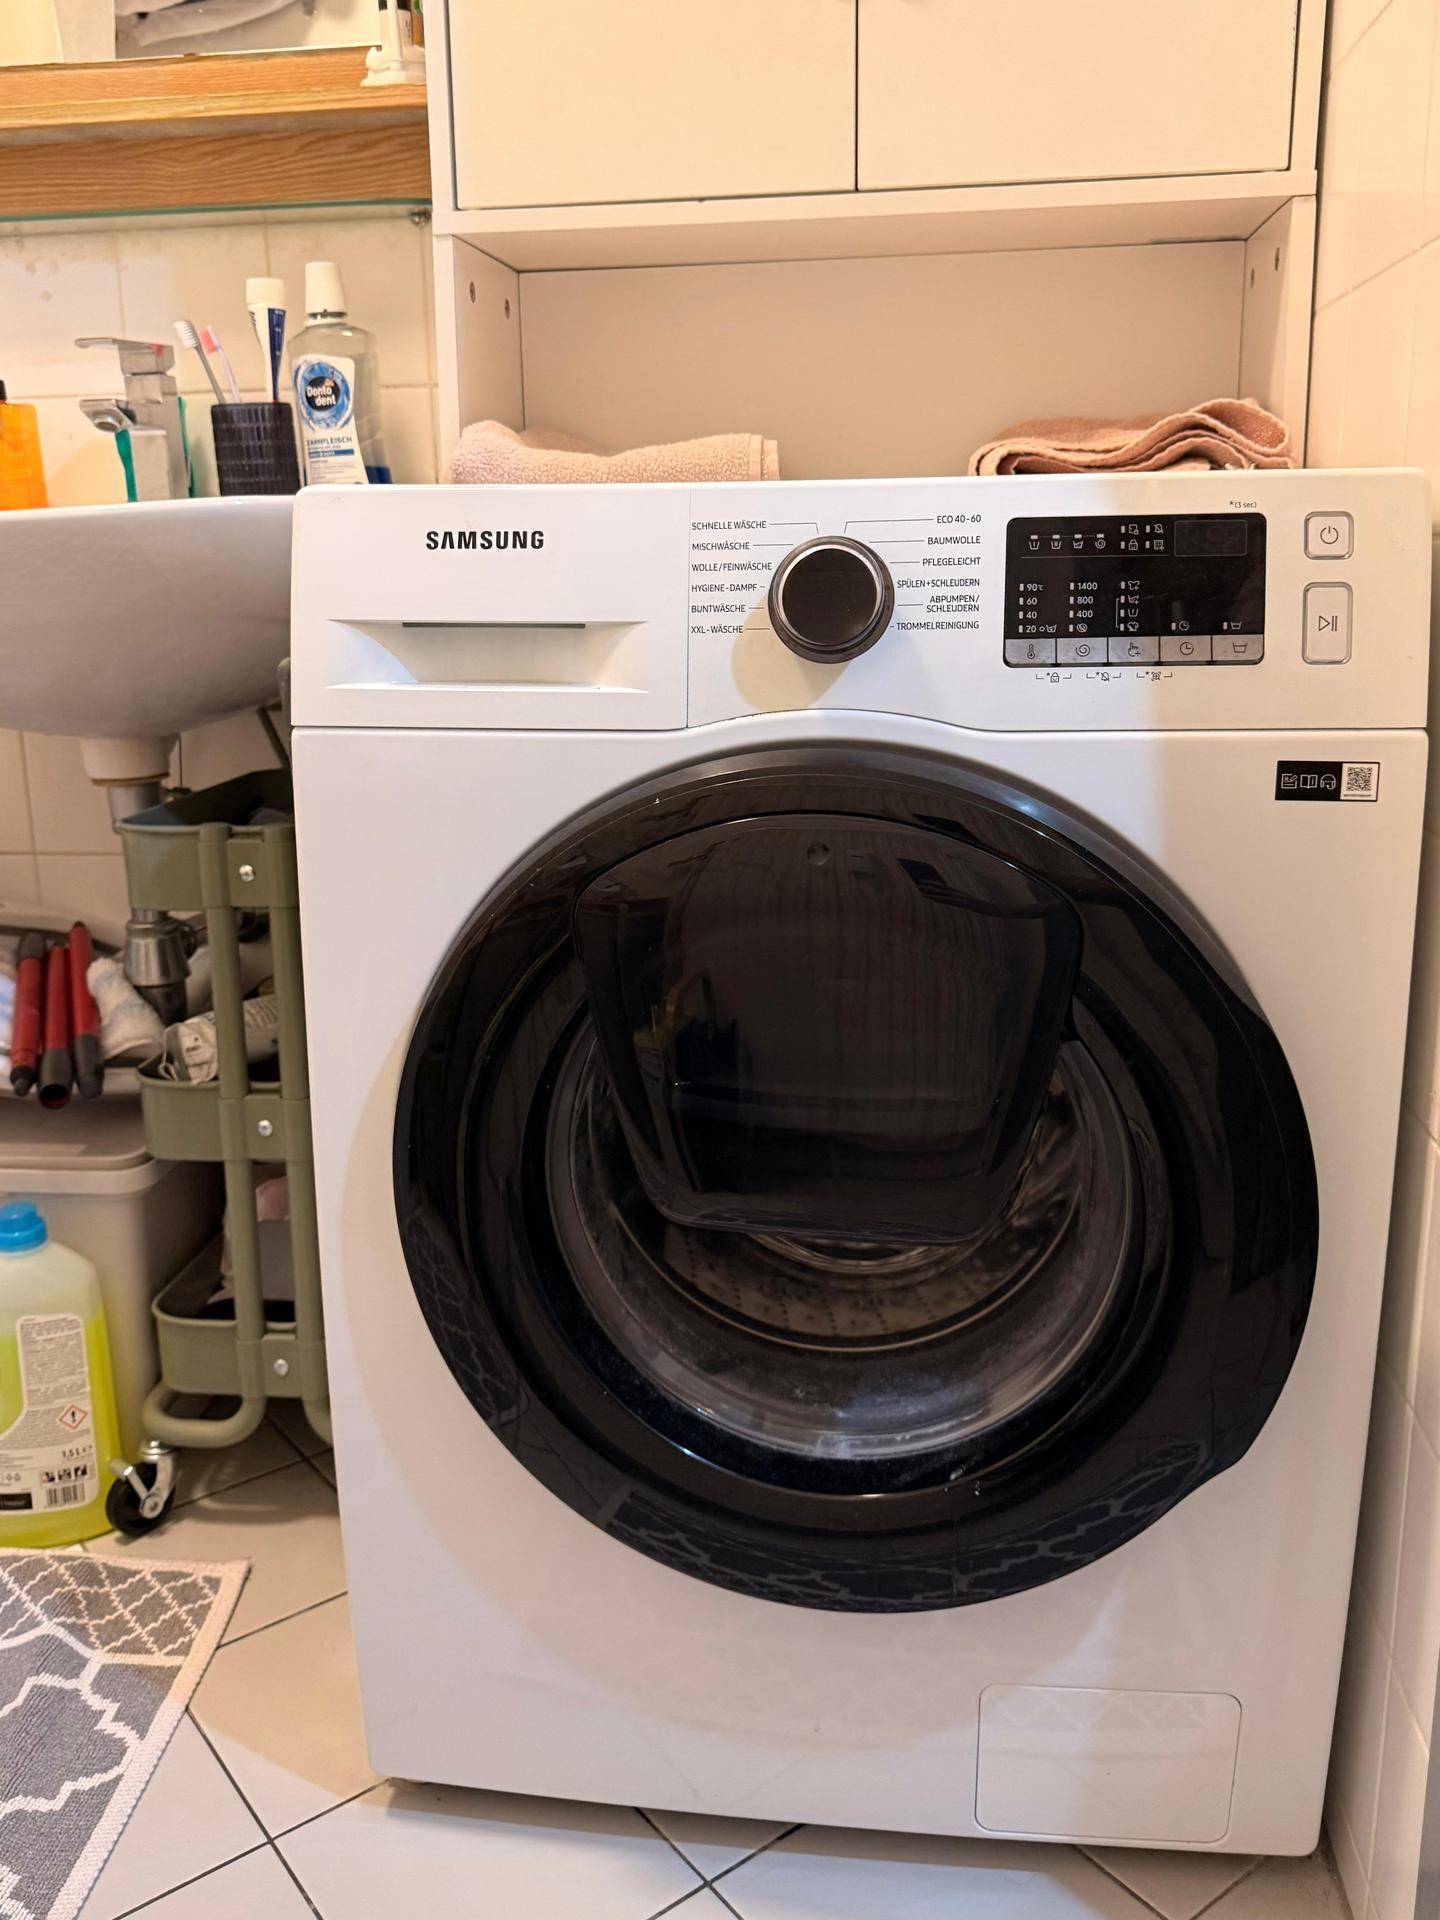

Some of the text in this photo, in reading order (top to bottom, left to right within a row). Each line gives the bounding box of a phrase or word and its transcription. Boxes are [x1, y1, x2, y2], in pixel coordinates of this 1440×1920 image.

[315, 394, 336, 406] dent
[1243, 501, 1257, 509] sec)
[937, 515, 954, 524] ECO
[692, 520, 767, 531] SCHNELLE WÄSCHE
[426, 530, 544, 550] SAMSUNG
[927, 535, 981, 546] BAUMWOLLE
[692, 541, 750, 551] MISCHWÄSCHE
[922, 557, 981, 567] PFLEGELEICHT
[691, 583, 757, 593] HYGIENE-DAMPF
[1077, 582, 1098, 590] 1400
[930, 594, 980, 603] ABPUMPEN/
[1026, 597, 1038, 606] 60
[1077, 596, 1094, 605] 800
[691, 603, 746, 614] BUNTWÄSCHE
[926, 603, 980, 614] SCHLEUDERN
[1026, 611, 1038, 620] 40
[1076, 610, 1094, 619] 400
[690, 623, 743, 634] XXL-WÄSCHE
[896, 620, 979, 631] TROMMELREINIGUNG
[1025, 625, 1037, 633] 20
